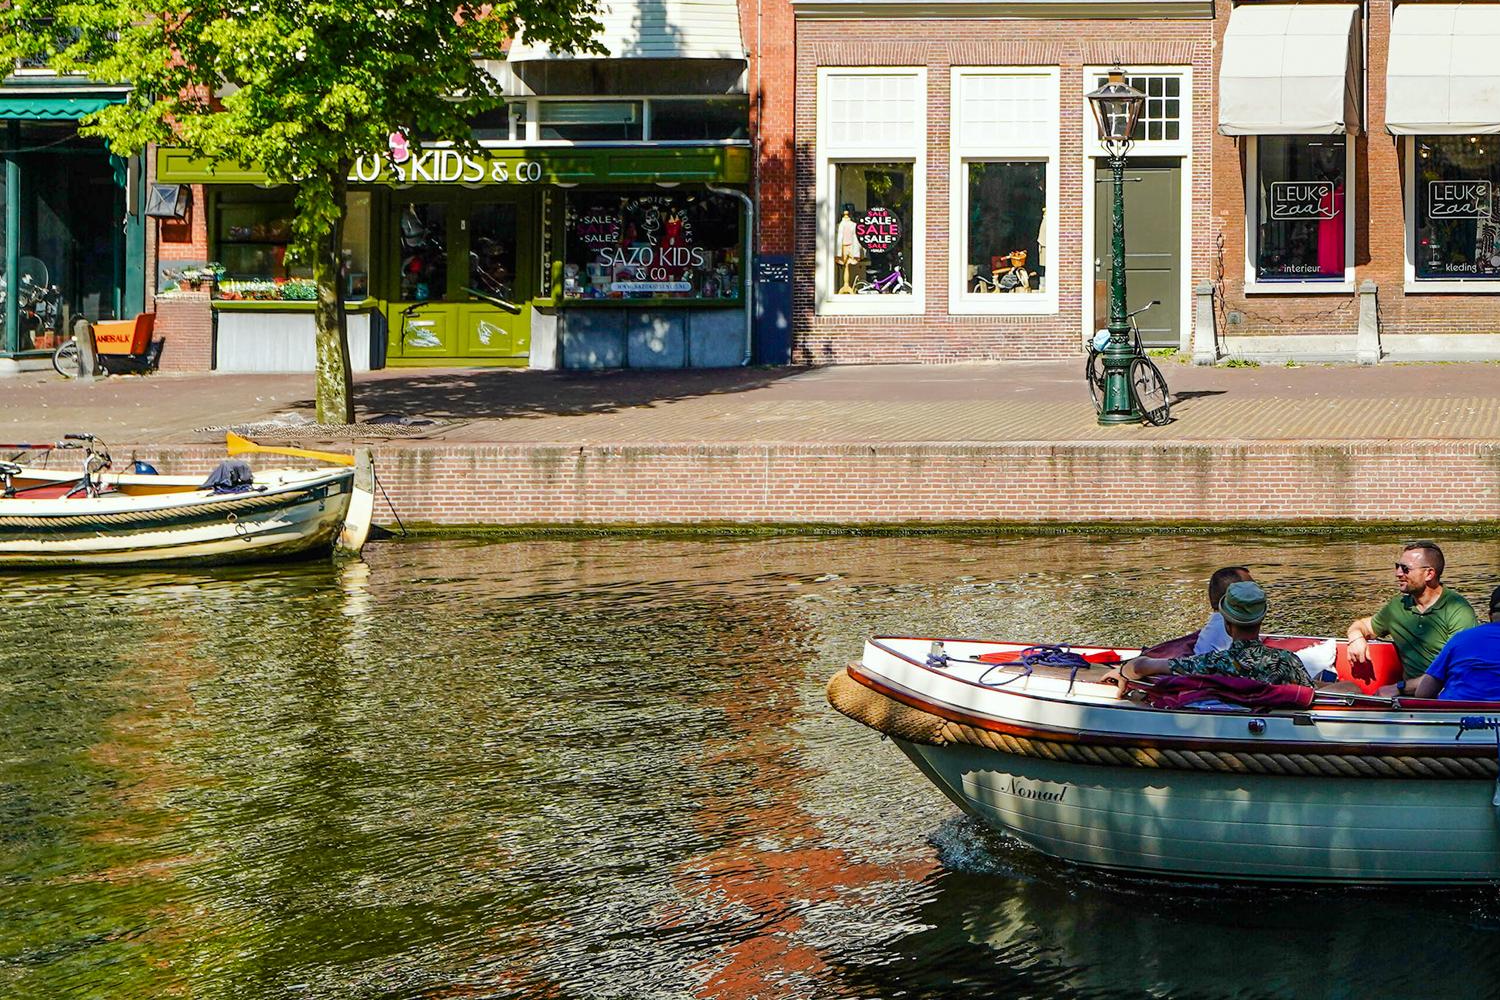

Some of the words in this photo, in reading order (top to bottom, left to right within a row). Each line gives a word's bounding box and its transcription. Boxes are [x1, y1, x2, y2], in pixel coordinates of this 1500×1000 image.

[411, 149, 486, 183] KIDS
[491, 161, 509, 182] &
[515, 161, 542, 183] CO
[1274, 197, 1340, 217] zaak
[584, 215, 612, 224] SALE
[864, 216, 892, 225] SALE
[677, 209, 694, 244] BOOKS
[856, 224, 898, 235] SALE
[584, 234, 612, 243] SALE
[864, 235, 892, 243] SALE
[599, 246, 654, 267] SAZO
[659, 246, 705, 267] KIDS
[1284, 263, 1321, 273] interieur
[1445, 263, 1478, 274] kleding
[635, 267, 647, 281] &
[650, 267, 667, 281] CO
[1001, 778, 1068, 801] Nomad
